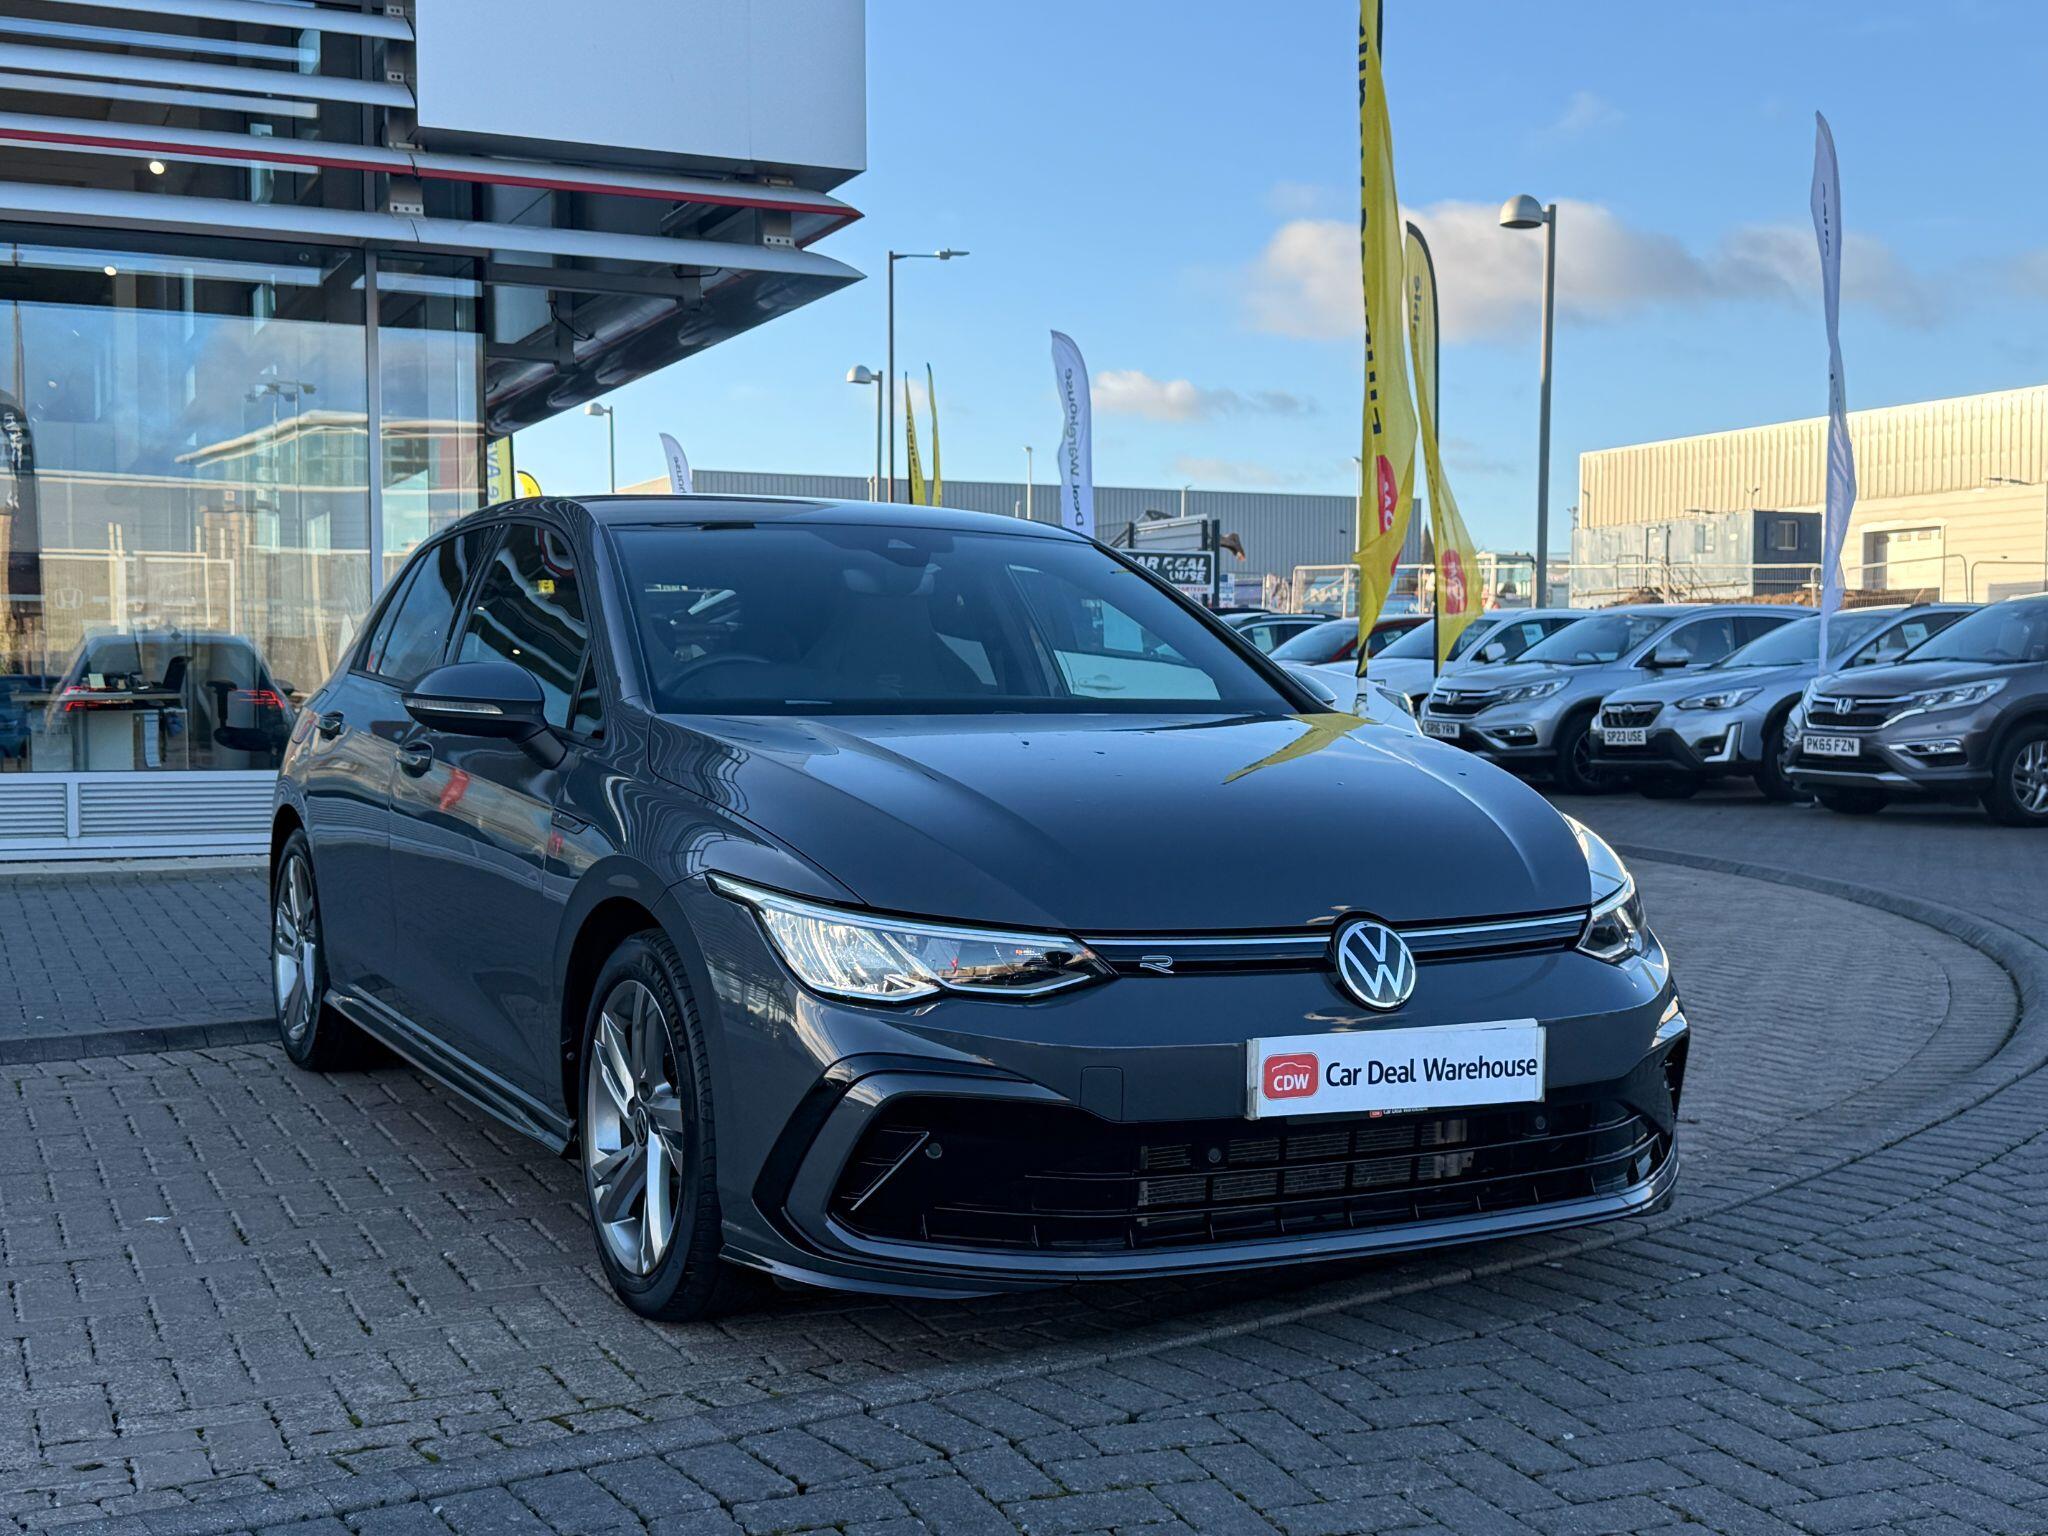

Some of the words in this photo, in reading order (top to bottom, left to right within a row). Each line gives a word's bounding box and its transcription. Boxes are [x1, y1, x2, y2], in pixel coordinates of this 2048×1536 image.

[1806, 738, 1831, 751] PK65
[1834, 739, 1854, 752] FZN
[1325, 1062, 1362, 1087] Car
[1367, 1058, 1417, 1085] Deal
[1423, 1055, 1538, 1082] Warehouse
[1273, 1073, 1310, 1091] CDW
